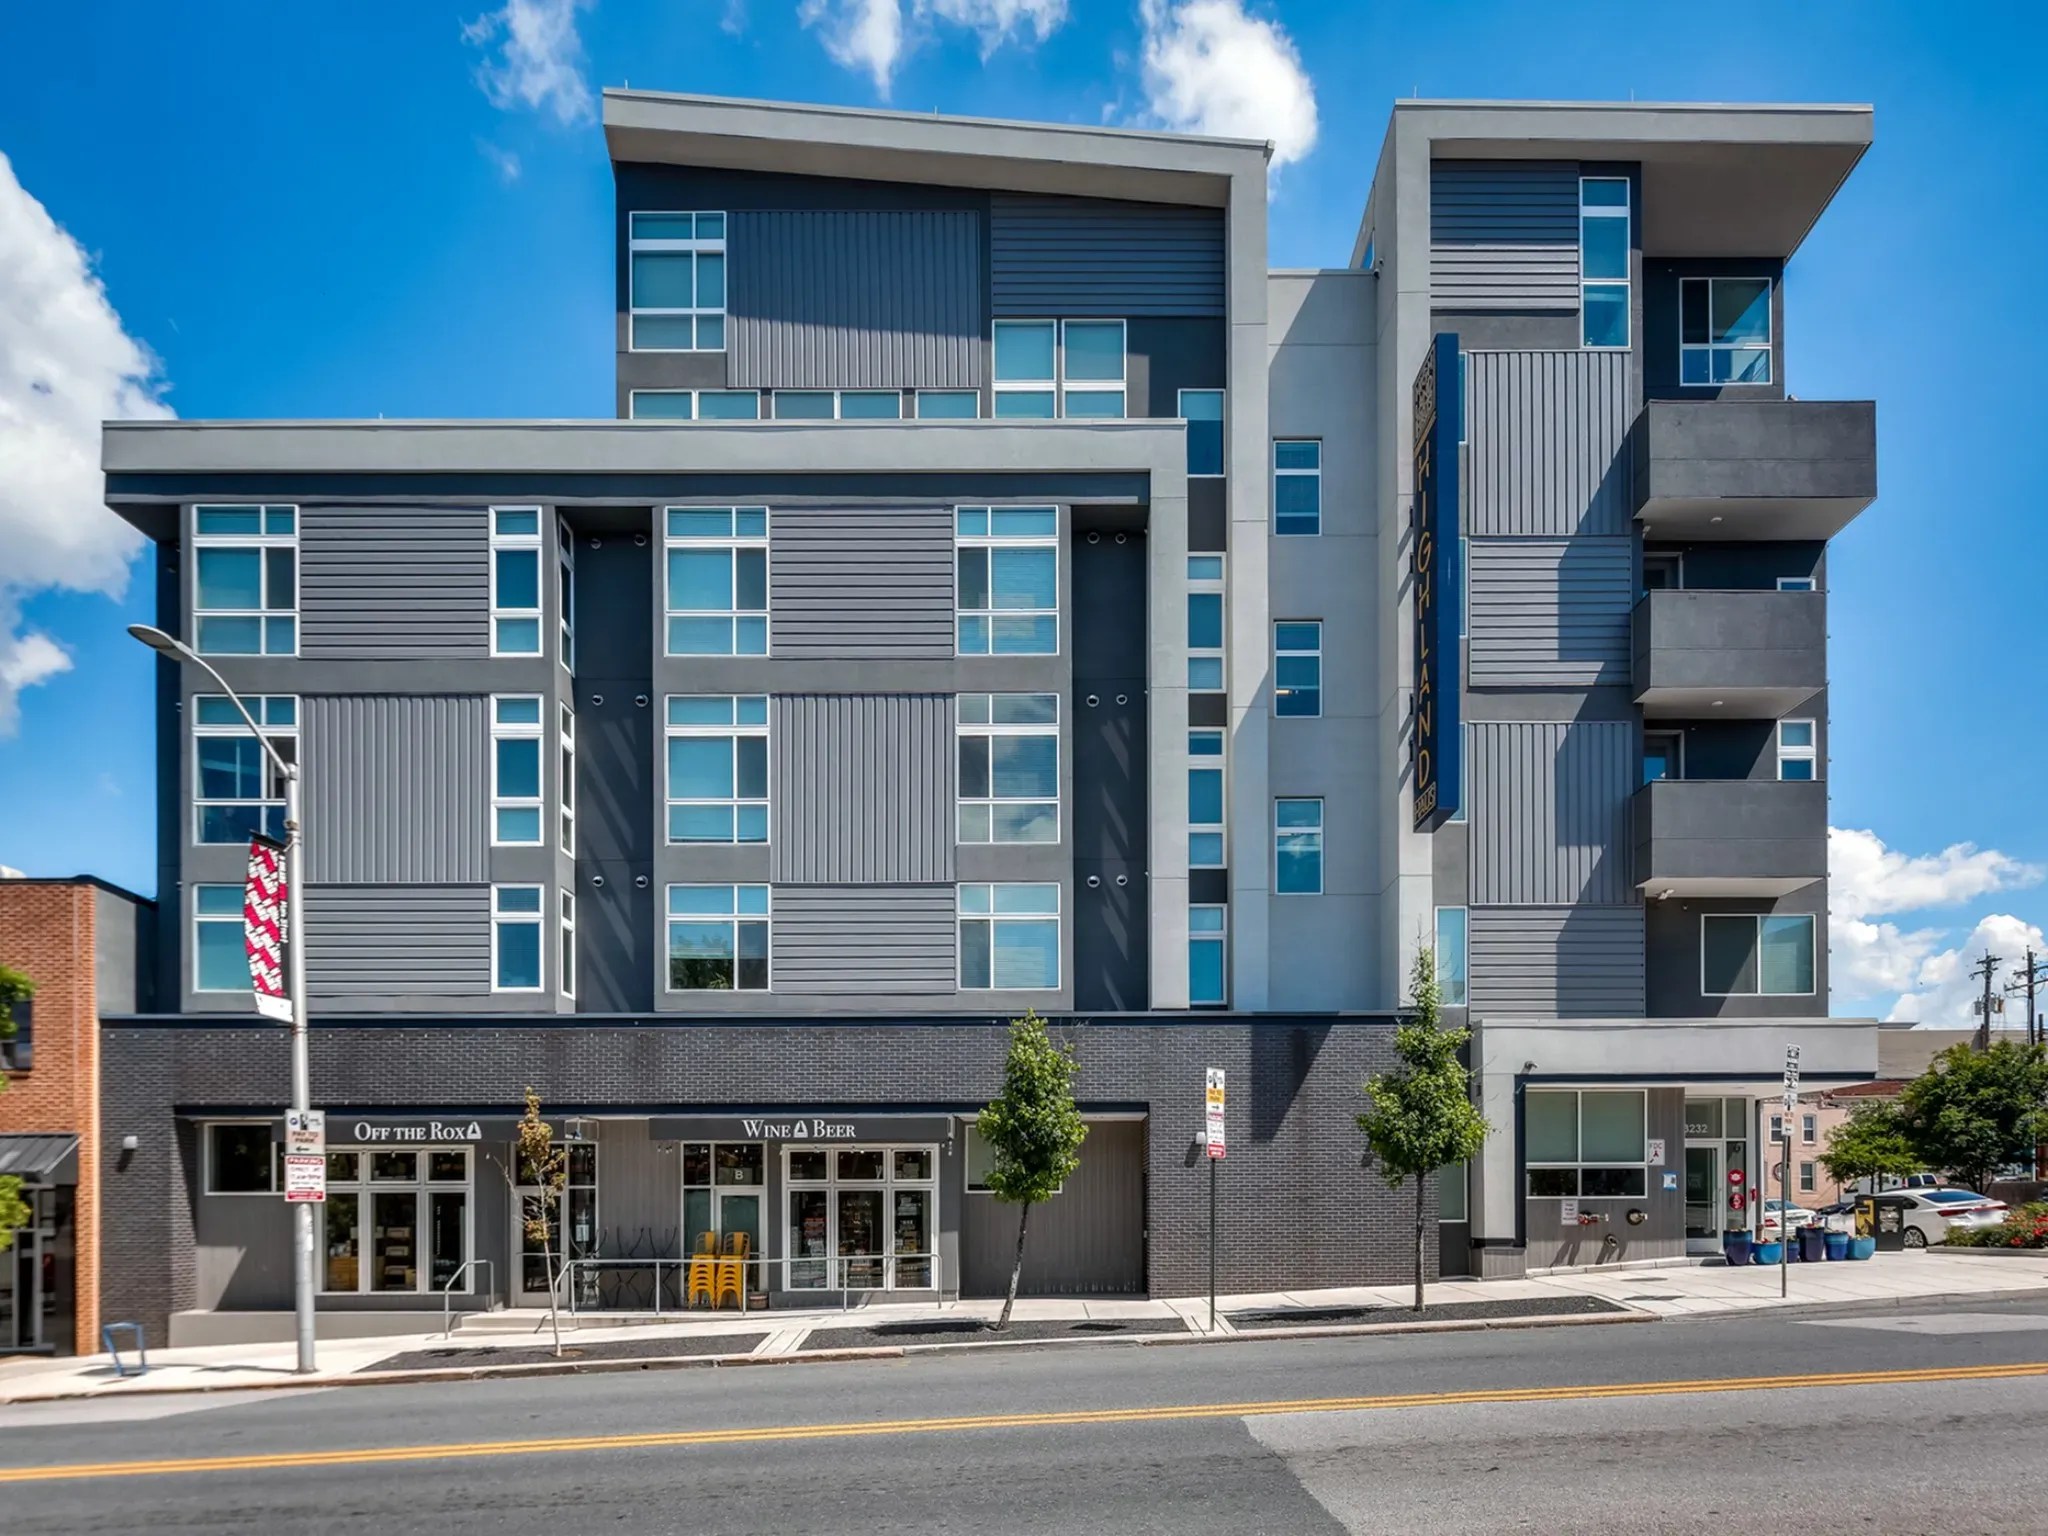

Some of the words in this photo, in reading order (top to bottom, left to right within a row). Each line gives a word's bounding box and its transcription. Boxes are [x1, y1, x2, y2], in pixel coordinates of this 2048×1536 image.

[1418, 440, 1431, 788] HIGHLAND
[354, 1121, 391, 1141] OFF
[393, 1127, 427, 1140] THE
[429, 1121, 466, 1140] ROX
[742, 1119, 791, 1138] WINE
[812, 1119, 857, 1138] BEER
[734, 1170, 743, 1180] B
